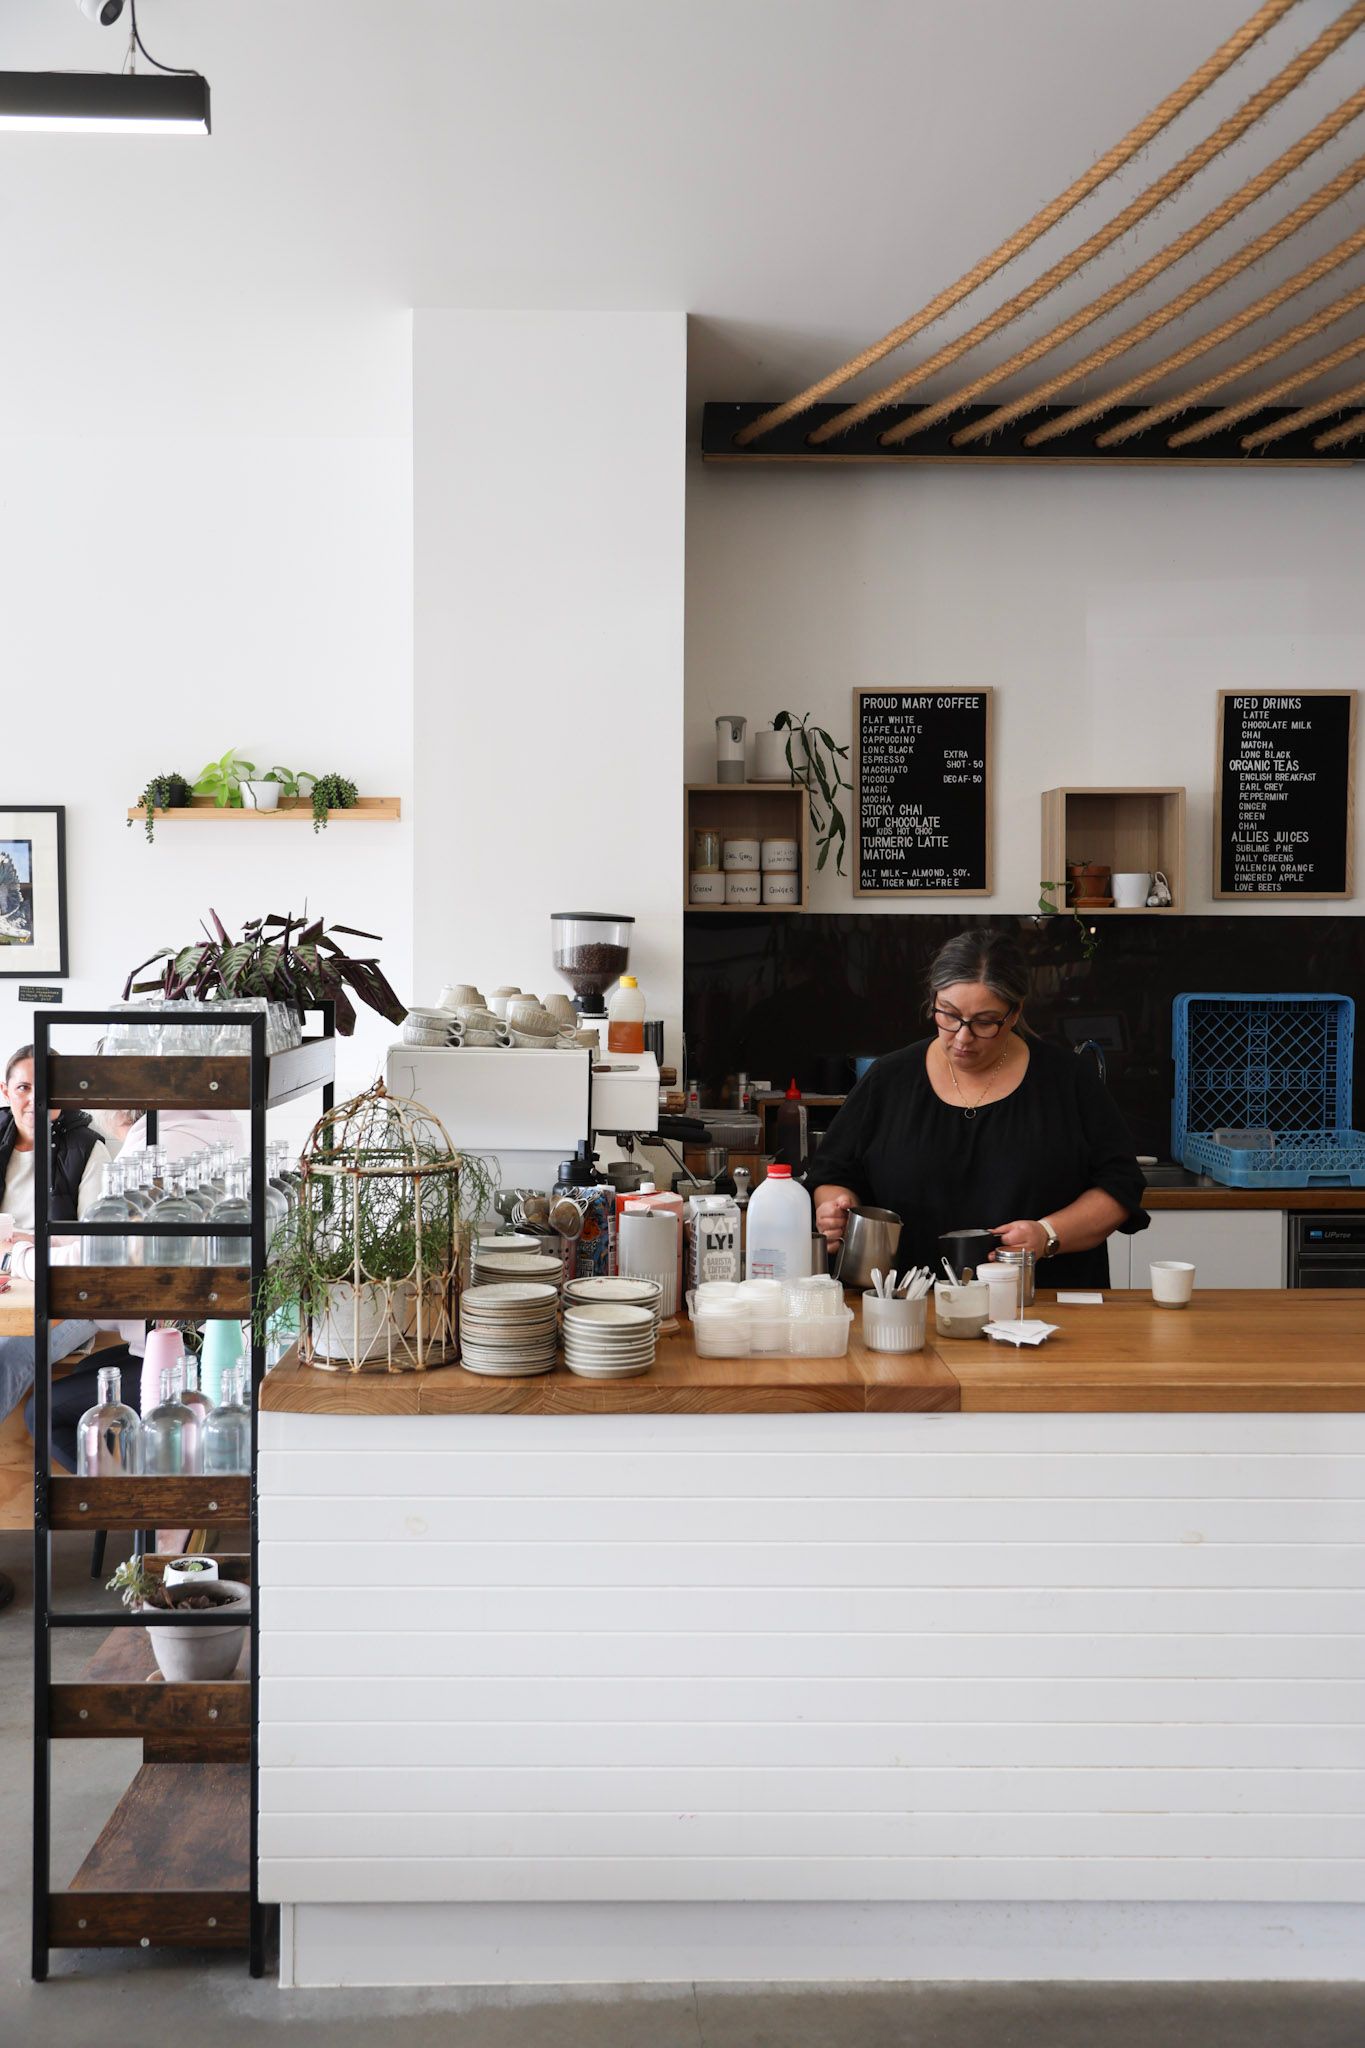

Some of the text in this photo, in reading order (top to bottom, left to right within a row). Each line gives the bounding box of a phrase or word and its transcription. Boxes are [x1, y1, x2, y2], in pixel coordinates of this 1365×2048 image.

[864, 697, 979, 709] PROUD MARY COFFEE
[1234, 698, 1301, 709] ICED DRINKS
[1244, 711, 1269, 719] LATTE
[1242, 721, 1311, 729] CHOCOLATE MILK
[863, 726, 890, 734] CAFFE
[1242, 731, 1260, 739] CHAI
[863, 736, 915, 744] CAPPUCCINO
[944, 750, 968, 758] EXTRA
[1241, 751, 1260, 759] LONG
[947, 760, 965, 768] SHOT
[1230, 760, 1299, 771] ORGANIC TEAS
[862, 775, 895, 783] PICCOLO
[1240, 773, 1316, 781] ENGLISH BREAKFAST
[863, 795, 891, 803] MOCHA
[862, 804, 922, 815] STICKY CHAI
[1239, 802, 1266, 810] GINGER
[1239, 812, 1264, 820] GREEN
[863, 816, 940, 828] HOT CHOCOLATE
[1239, 822, 1256, 830] CHAI
[896, 828, 910, 836] HOT
[915, 827, 933, 836] CHOC
[1231, 831, 1309, 842] ALLIES JUICES
[862, 836, 948, 847] TURMERIC LATTE
[1236, 844, 1269, 852] SUBLIME
[864, 849, 905, 859] MATCHA
[1236, 854, 1293, 862] DAILY GREENS
[1235, 864, 1313, 872] VALENCIA ORANGE
[862, 869, 876, 877] ALT
[881, 869, 899, 877] MILK
[1235, 873, 1304, 881] GINGERED APPLE
[882, 879, 904, 887] TIGER
[1235, 883, 1281, 891] LOVE BEETS
[707, 1234, 733, 1249] LY!
[707, 1257, 732, 1266] BARISTA
[708, 1266, 731, 1274] EDITION
